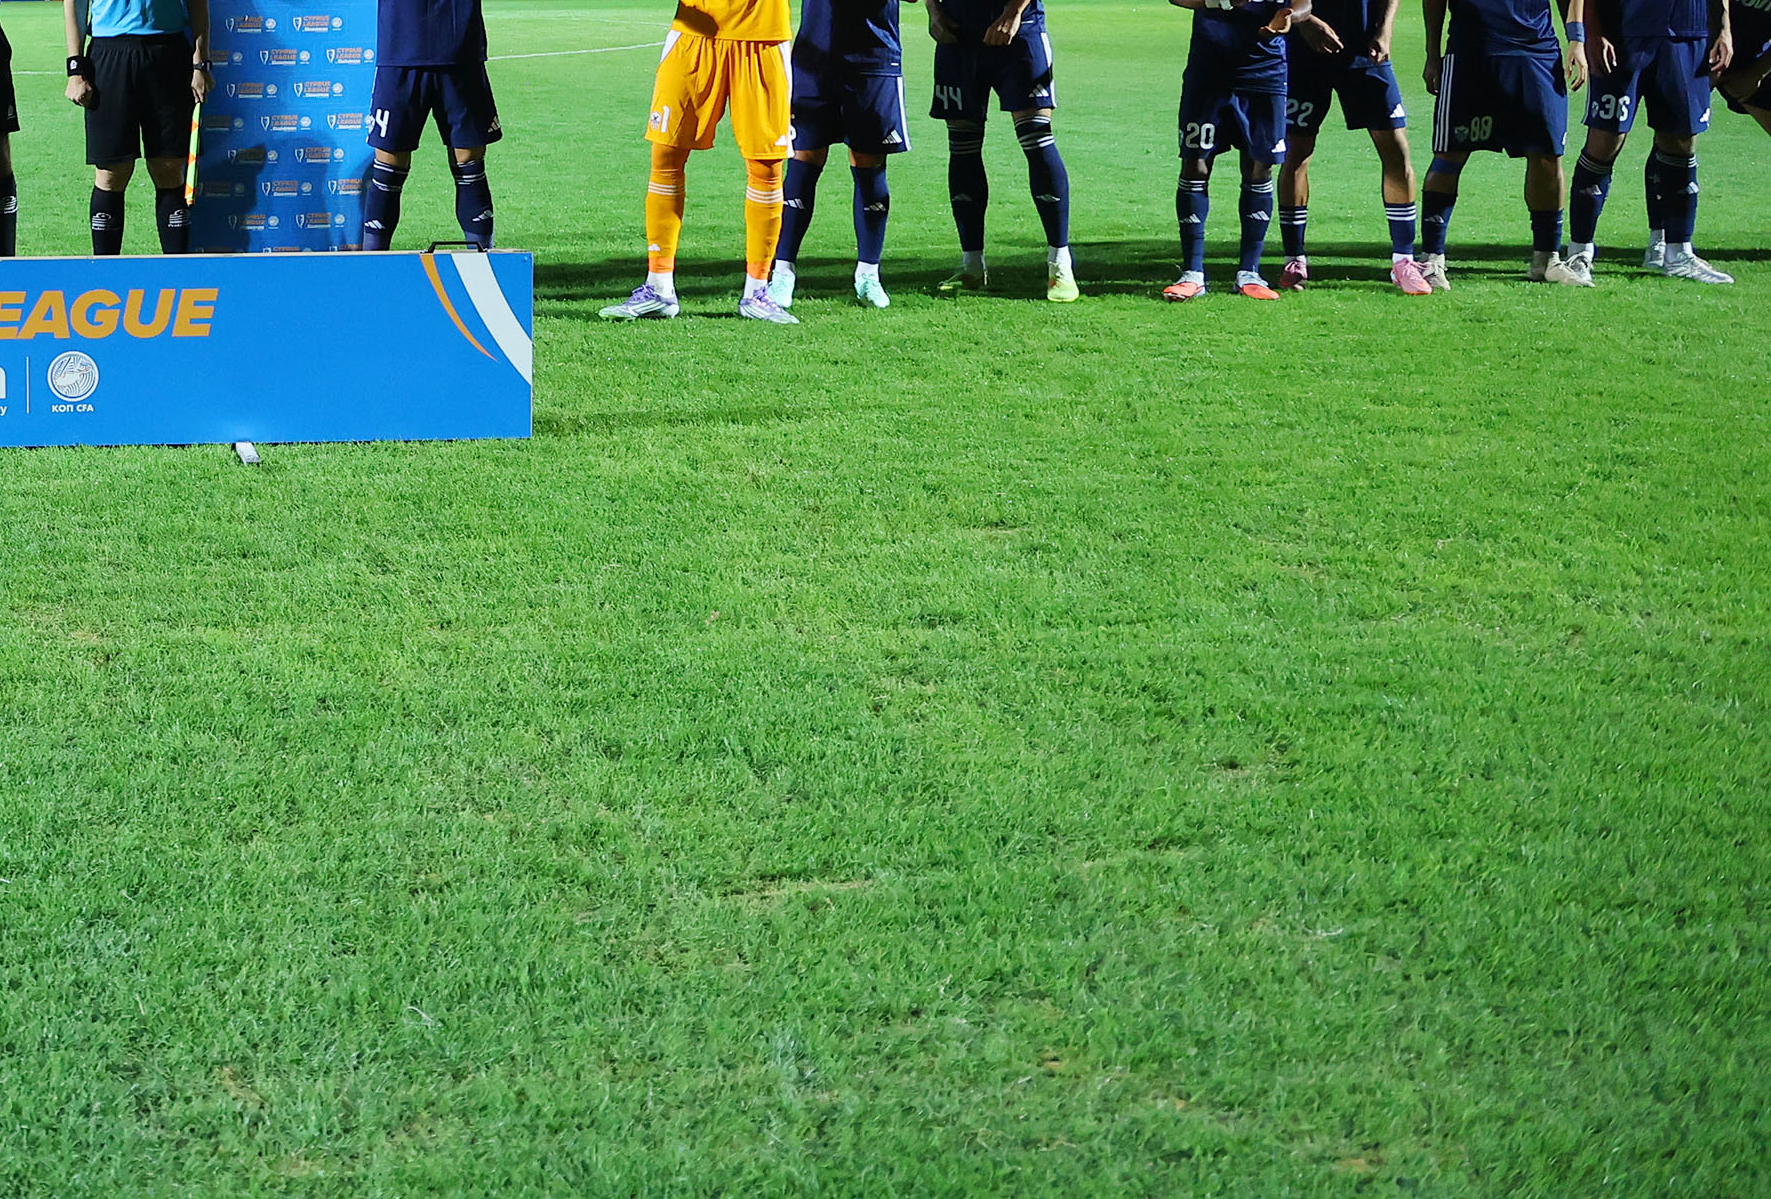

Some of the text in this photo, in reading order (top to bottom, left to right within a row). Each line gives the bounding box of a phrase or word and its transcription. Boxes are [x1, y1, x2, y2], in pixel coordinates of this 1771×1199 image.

[936, 84, 963, 111] 44
[375, 108, 390, 138] 4
[660, 105, 671, 133] 1
[1286, 98, 1314, 128] 22
[1185, 122, 1216, 150] 20
[1470, 116, 1493, 142] 88
[75, 403, 94, 412] CFA
